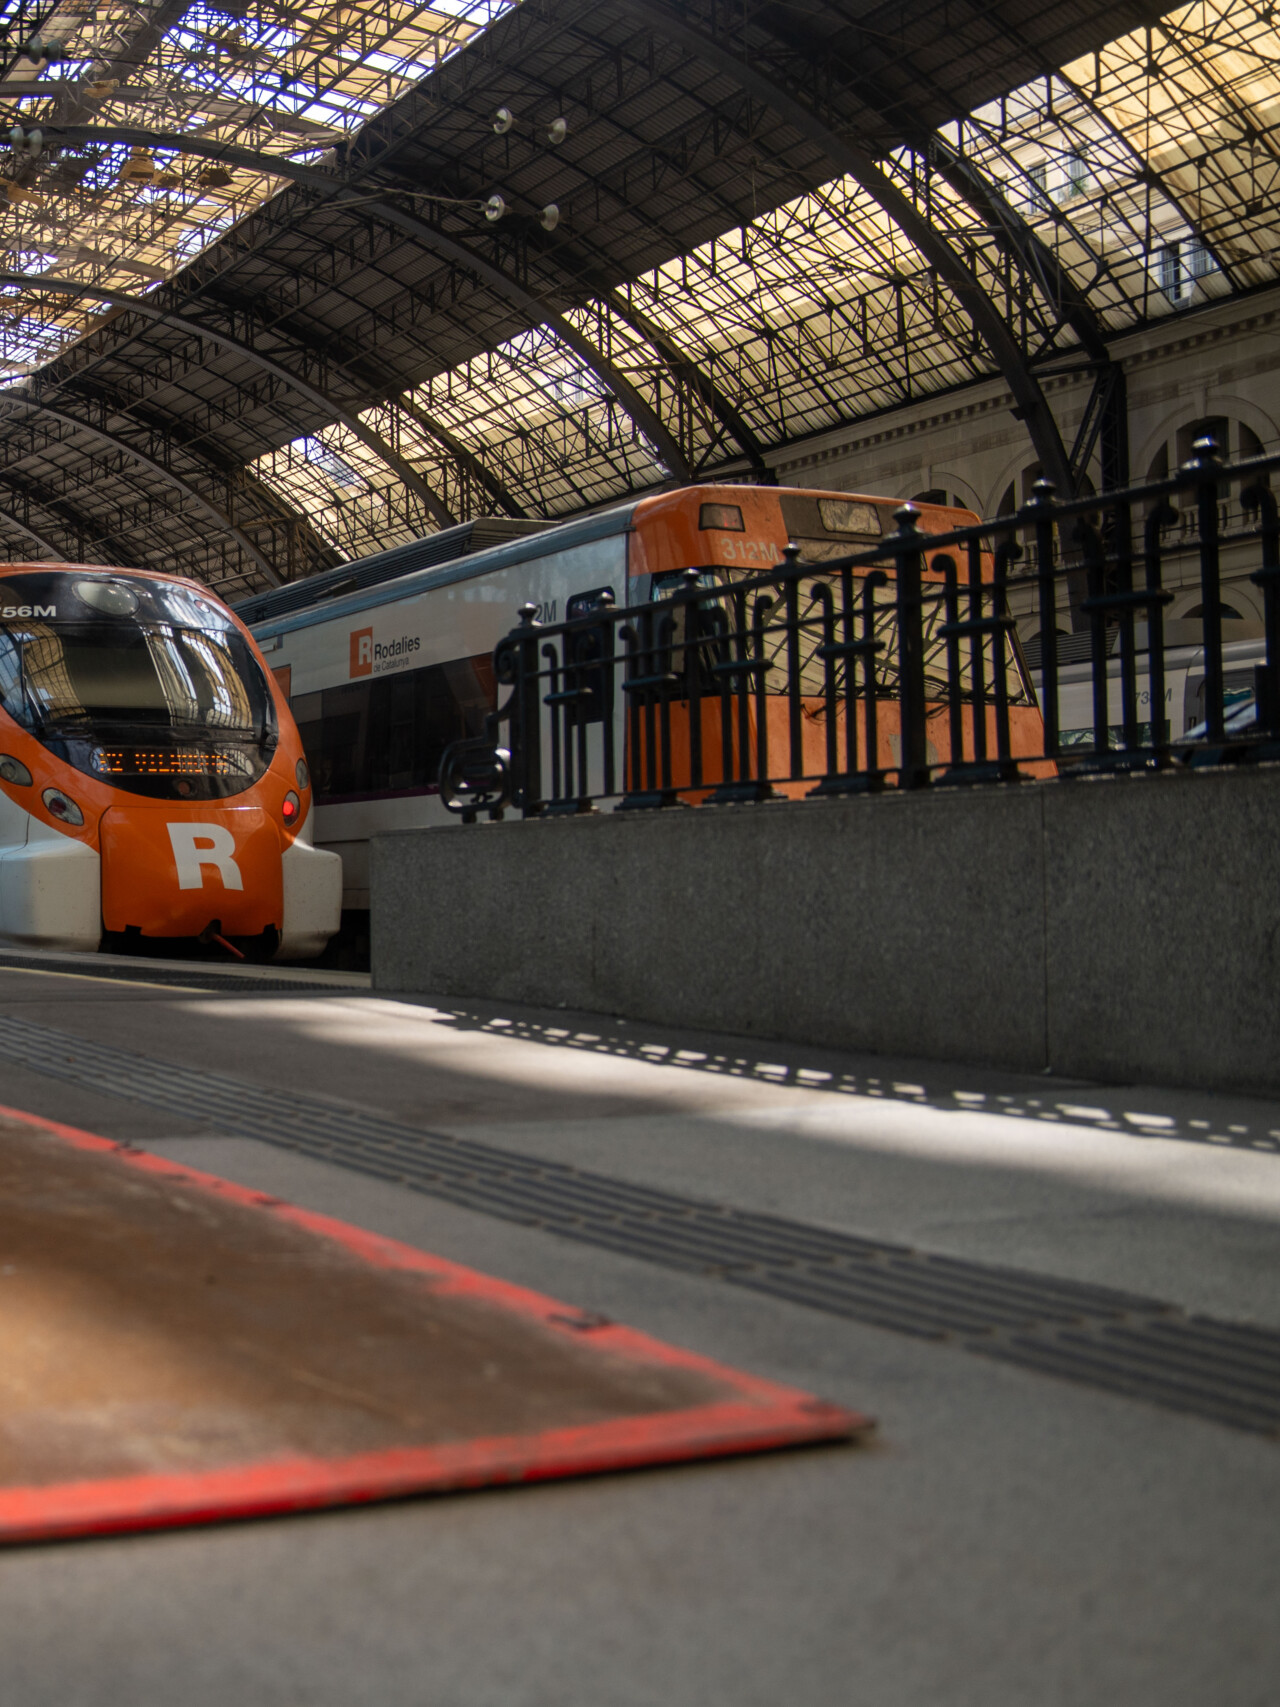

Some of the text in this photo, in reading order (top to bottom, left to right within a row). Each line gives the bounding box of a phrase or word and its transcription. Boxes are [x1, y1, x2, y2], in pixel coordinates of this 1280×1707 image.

[721, 538, 780, 563] 312M
[358, 635, 372, 666] R
[374, 636, 421, 660] Rodalies
[373, 657, 409, 673] de Catalunya
[166, 822, 244, 891] R
